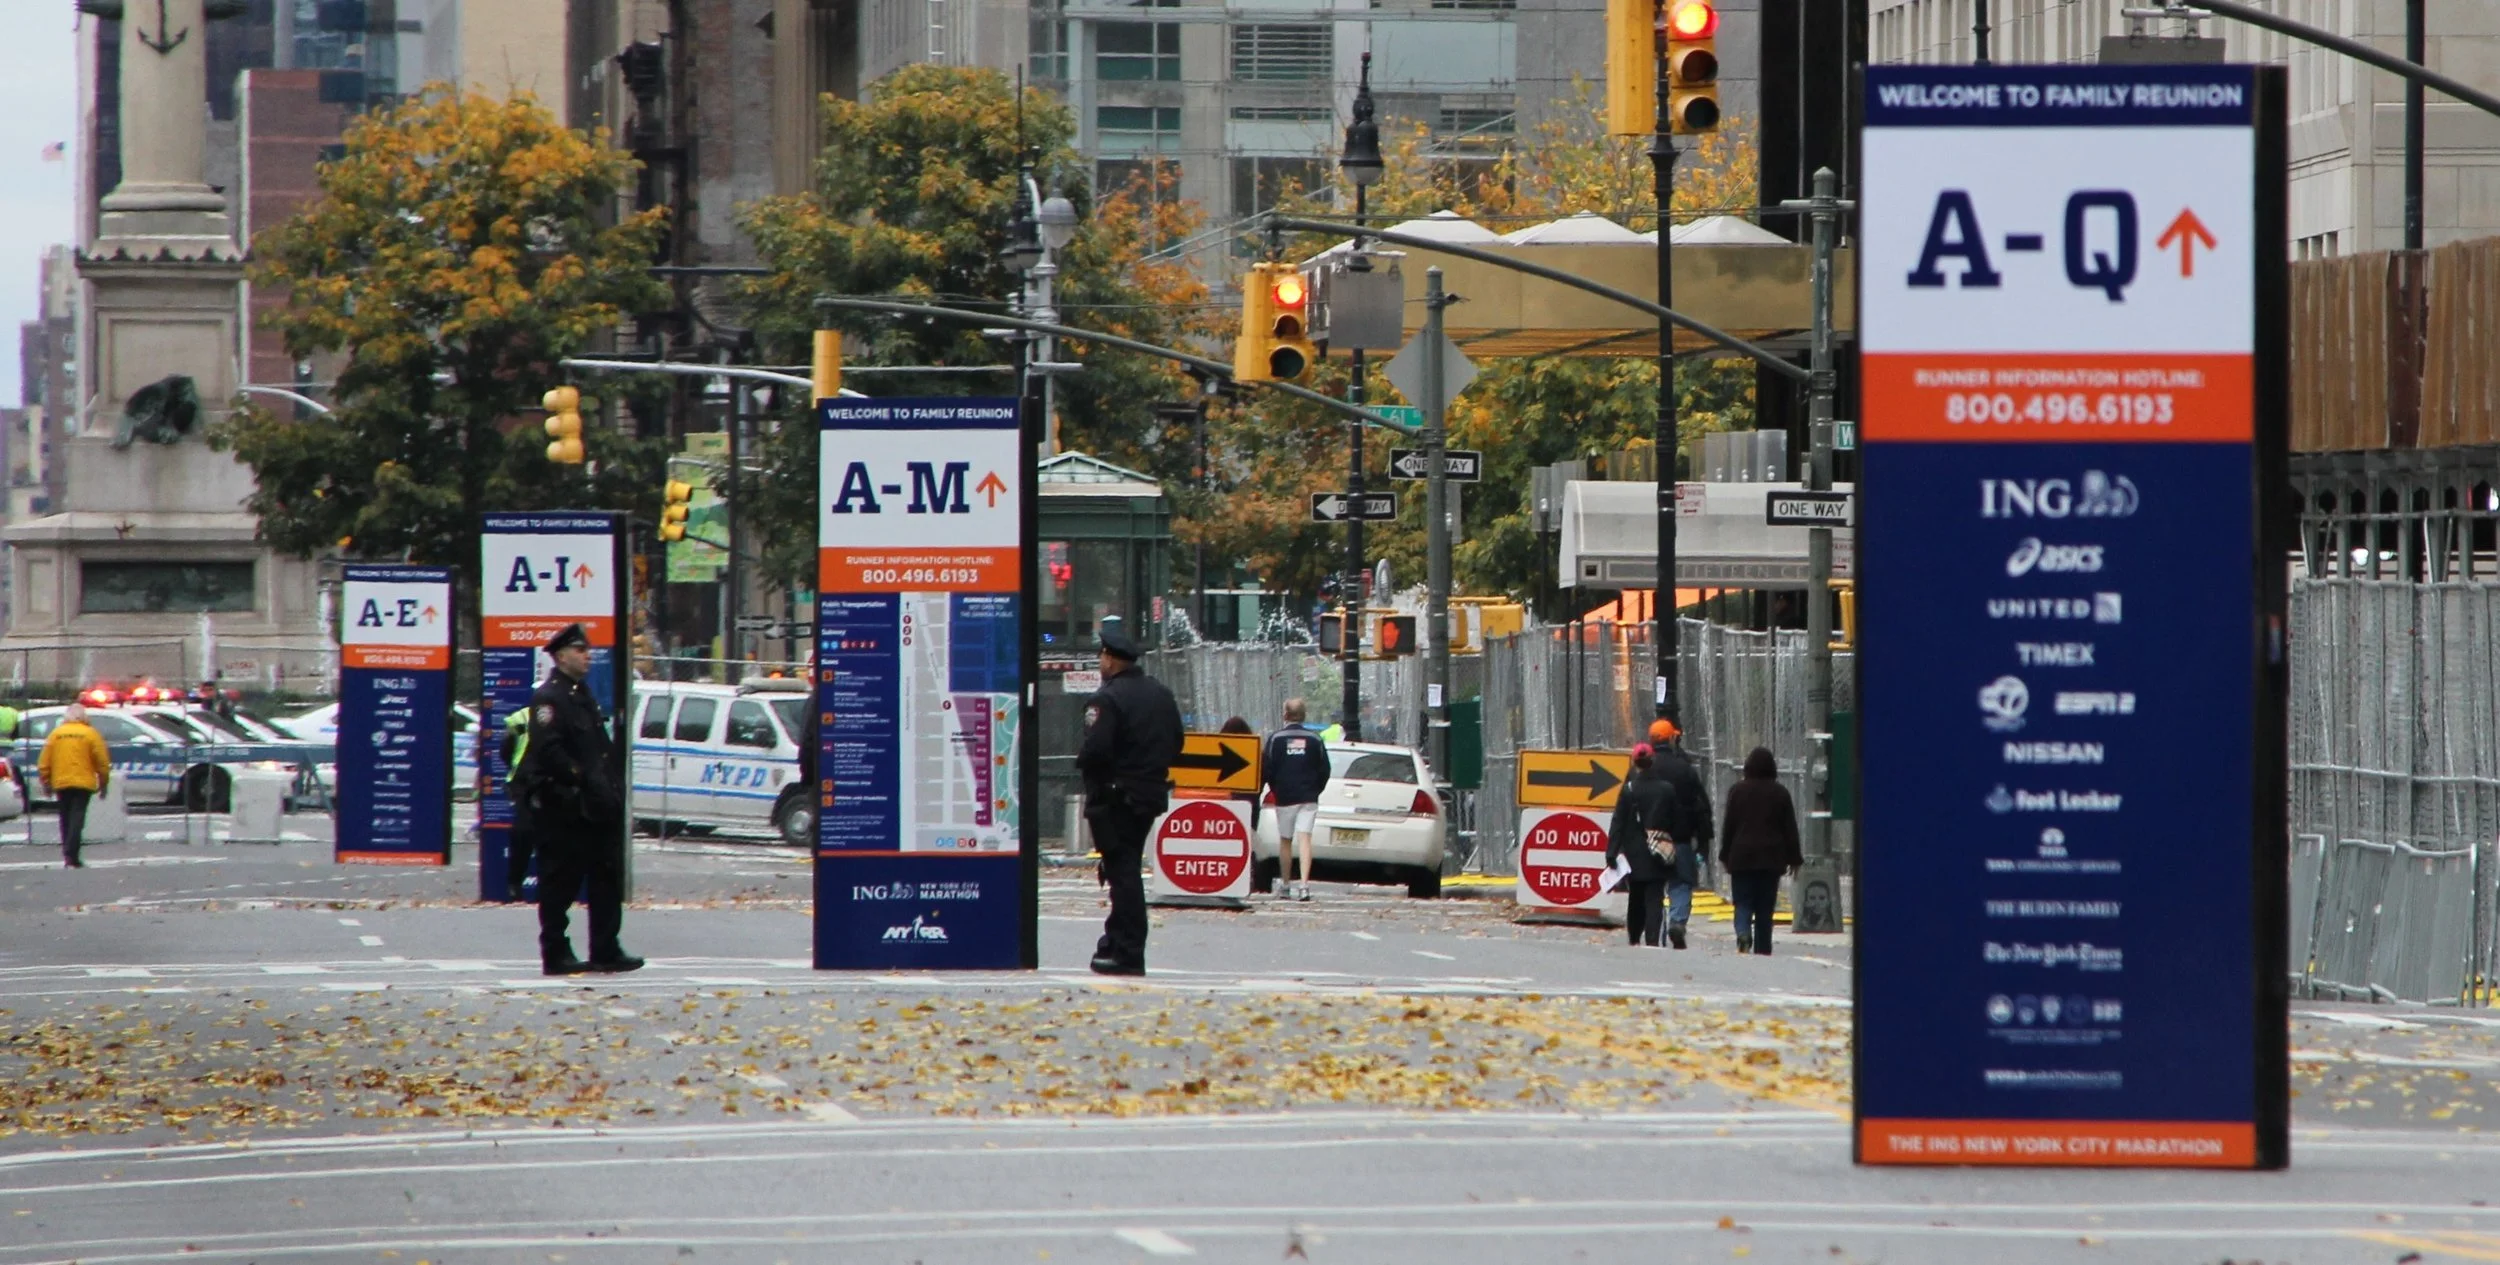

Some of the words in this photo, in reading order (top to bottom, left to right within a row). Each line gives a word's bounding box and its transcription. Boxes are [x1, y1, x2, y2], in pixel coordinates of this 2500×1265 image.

[1878, 85, 2000, 107] WELCOME
[2006, 85, 2039, 107] TO
[2045, 85, 2129, 107] FAMILY
[2134, 84, 2242, 106] REUNION
[1907, 188, 2139, 303] A-Q
[1914, 370, 1990, 387] RUNNER
[1994, 370, 2119, 387] INFORMATION
[828, 408, 890, 420] WELCOME
[893, 408, 909, 419] TO
[913, 408, 956, 419] FAMILY
[957, 407, 1013, 418] REUNION
[1946, 394, 2173, 424] 800.496.6193
[831, 461, 970, 514] A-M
[1979, 478, 2073, 518] ING
[1779, 503, 1807, 516] ONE
[1814, 503, 1844, 516] WAY
[486, 519, 528, 527] WELCOME
[530, 519, 541, 527] TO
[572, 519, 610, 527] REUNION
[846, 556, 884, 564] RUNNER
[886, 556, 950, 564] INFORMATION
[505, 556, 570, 592] A-I
[862, 569, 978, 583] 800.496.6193
[357, 599, 419, 628] A-E
[1986, 598, 2091, 618] UNITED
[2016, 641, 2095, 666] TIMEX
[1286, 747, 1306, 755] USA
[2004, 741, 2104, 764] NISSAN
[700, 763, 767, 788] NYPD
[1169, 818, 1193, 834] DO
[1203, 819, 1236, 835] NOT
[1535, 829, 1558, 845] DO
[1567, 830, 1601, 846] NOT
[1175, 859, 1229, 877] ENTER
[1539, 871, 1592, 889] ENTER
[853, 885, 888, 900] ING
[919, 890, 980, 900] MARATHON
[1888, 1135, 1923, 1152] THE
[1928, 1136, 1960, 1152] ING
[1966, 1136, 2010, 1152] NEW
[2014, 1137, 2062, 1153] YORK
[2067, 1138, 2111, 1154] CITY
[2116, 1138, 2222, 1155] MARATHON
